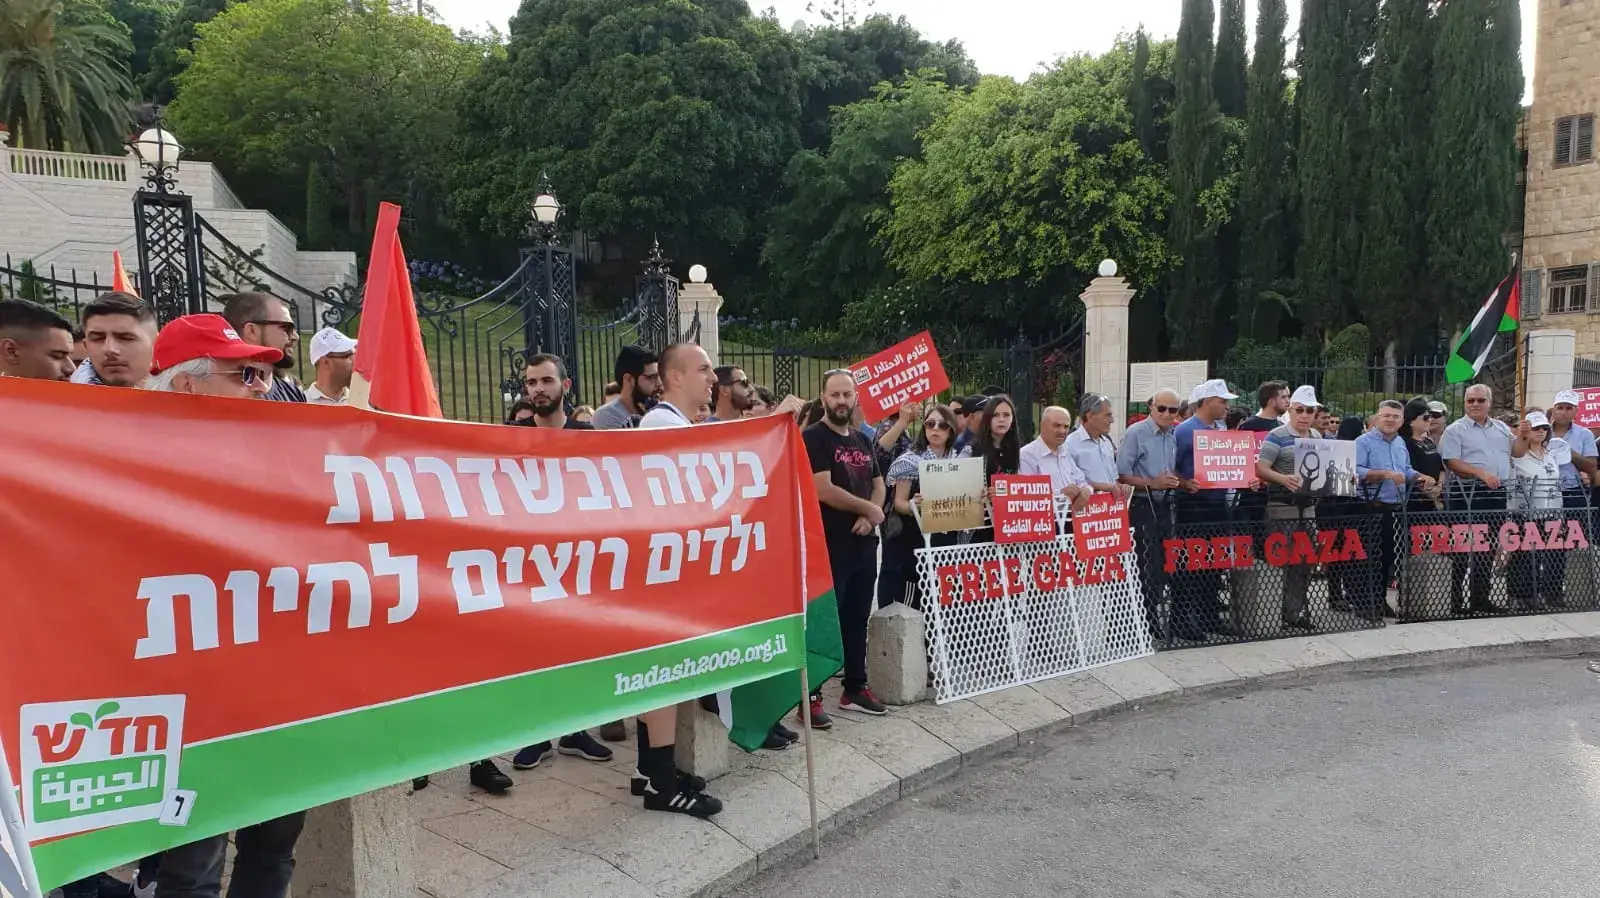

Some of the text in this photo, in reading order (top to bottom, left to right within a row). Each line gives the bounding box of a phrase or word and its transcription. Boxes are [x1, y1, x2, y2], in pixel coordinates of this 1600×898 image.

[873, 353, 904, 378] الاحتلال
[868, 360, 931, 397] מתנגדים
[878, 378, 930, 410] לכיבוש
[1210, 438, 1232, 450] الاحتلال
[1203, 455, 1247, 466] מתנגדים
[324, 451, 768, 524] בעזה ובשדרות
[1207, 469, 1244, 482] לכיבוש
[1010, 482, 1050, 495] מתנגדים
[1008, 498, 1051, 513] לפאשיזם
[1087, 502, 1108, 517] الاحتلال
[1002, 518, 1031, 537] الفاشية
[1081, 517, 1122, 534] מתנגדים
[1409, 519, 1590, 557] FREE GAZA
[1086, 532, 1121, 551] לכיבוש
[1162, 528, 1369, 574] FREE GAZA
[134, 514, 766, 660] ילדים רוצים לחיות
[936, 551, 1127, 607] FREE GAZA
[614, 633, 787, 695] hadash2009.org.il
[41, 759, 160, 812] الجبهة
